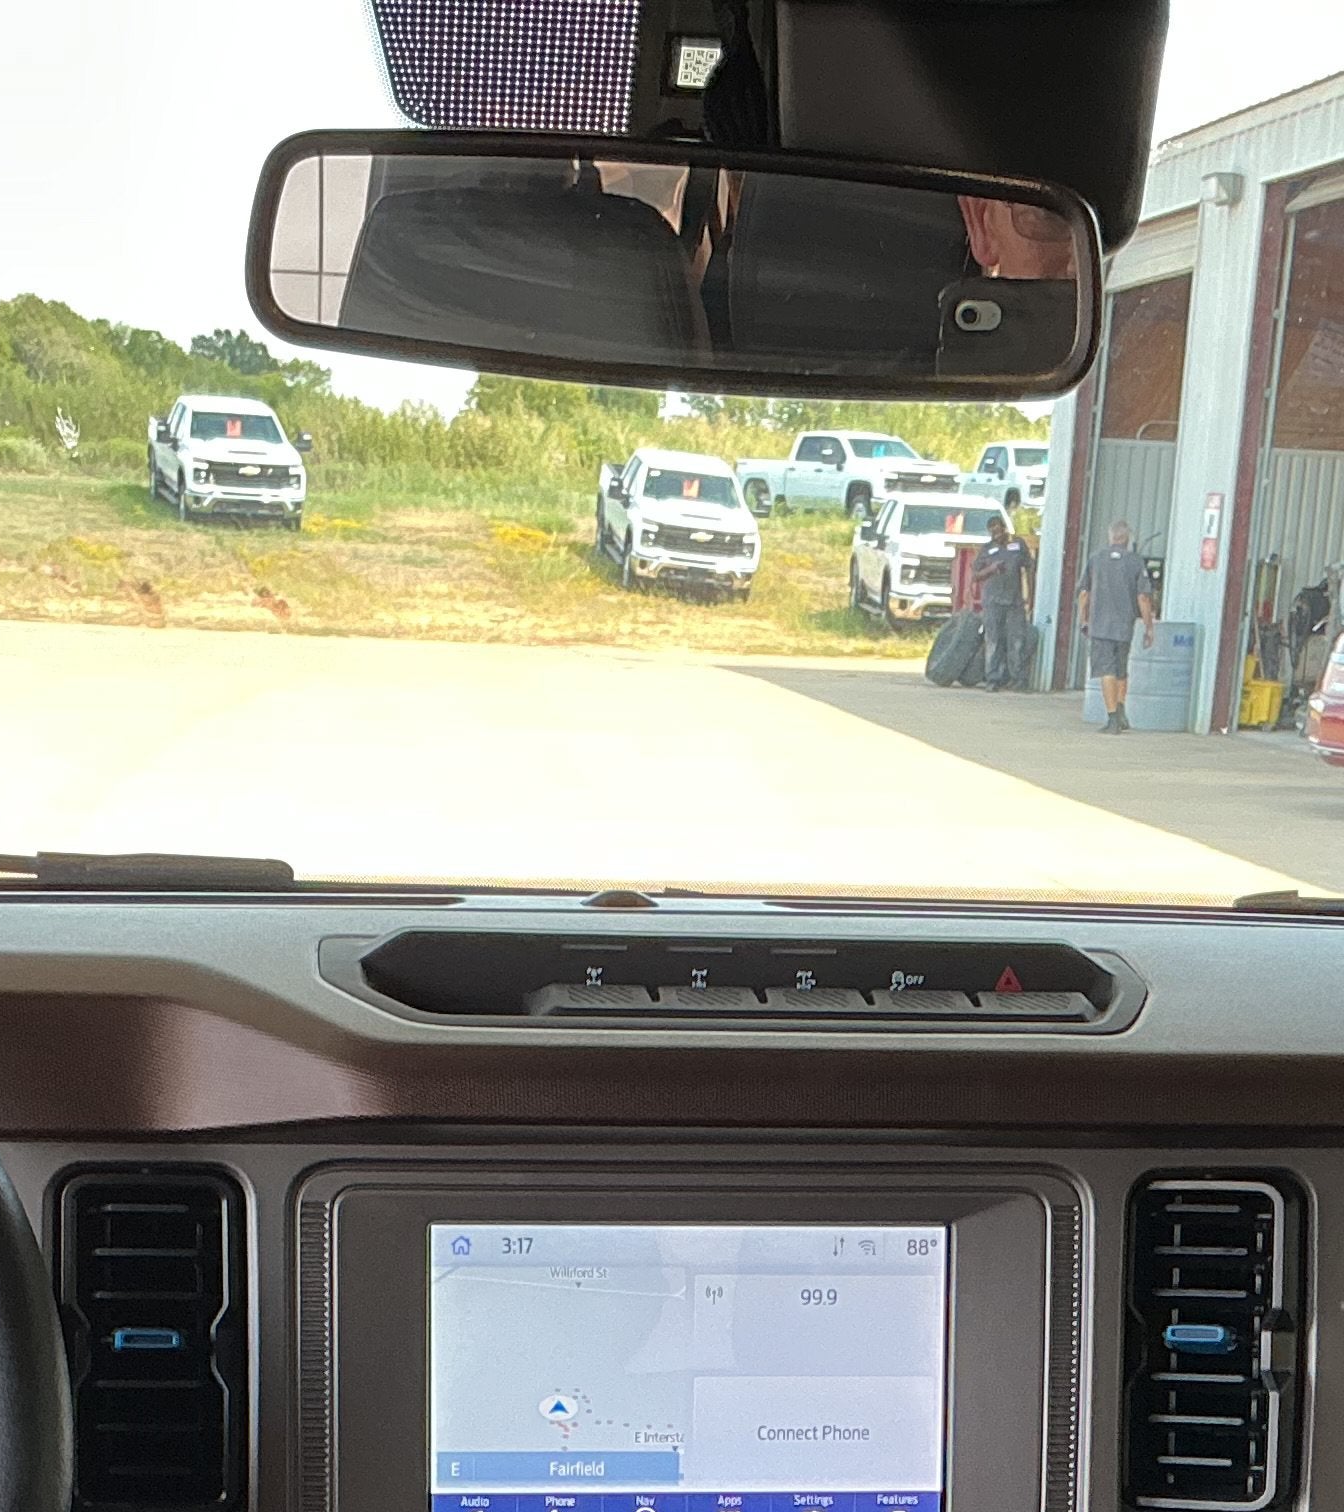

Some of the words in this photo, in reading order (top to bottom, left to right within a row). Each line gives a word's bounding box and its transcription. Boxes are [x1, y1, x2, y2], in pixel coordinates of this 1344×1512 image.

[905, 974, 924, 985] OFF
[501, 1237, 534, 1255] 3:17
[596, 1266, 608, 1279] St
[800, 1288, 838, 1307] 99.9
[634, 1431, 641, 1444] E
[757, 1424, 817, 1442] Connect
[821, 1424, 870, 1442] Phone
[451, 1462, 460, 1477] E
[549, 1460, 606, 1478] Fairfield
[460, 1495, 490, 1508] Audio
[545, 1495, 576, 1508] Phone
[635, 1495, 655, 1508] Nav
[717, 1495, 743, 1509] Apps
[793, 1494, 834, 1509] Settings
[876, 1495, 919, 1508] Features
